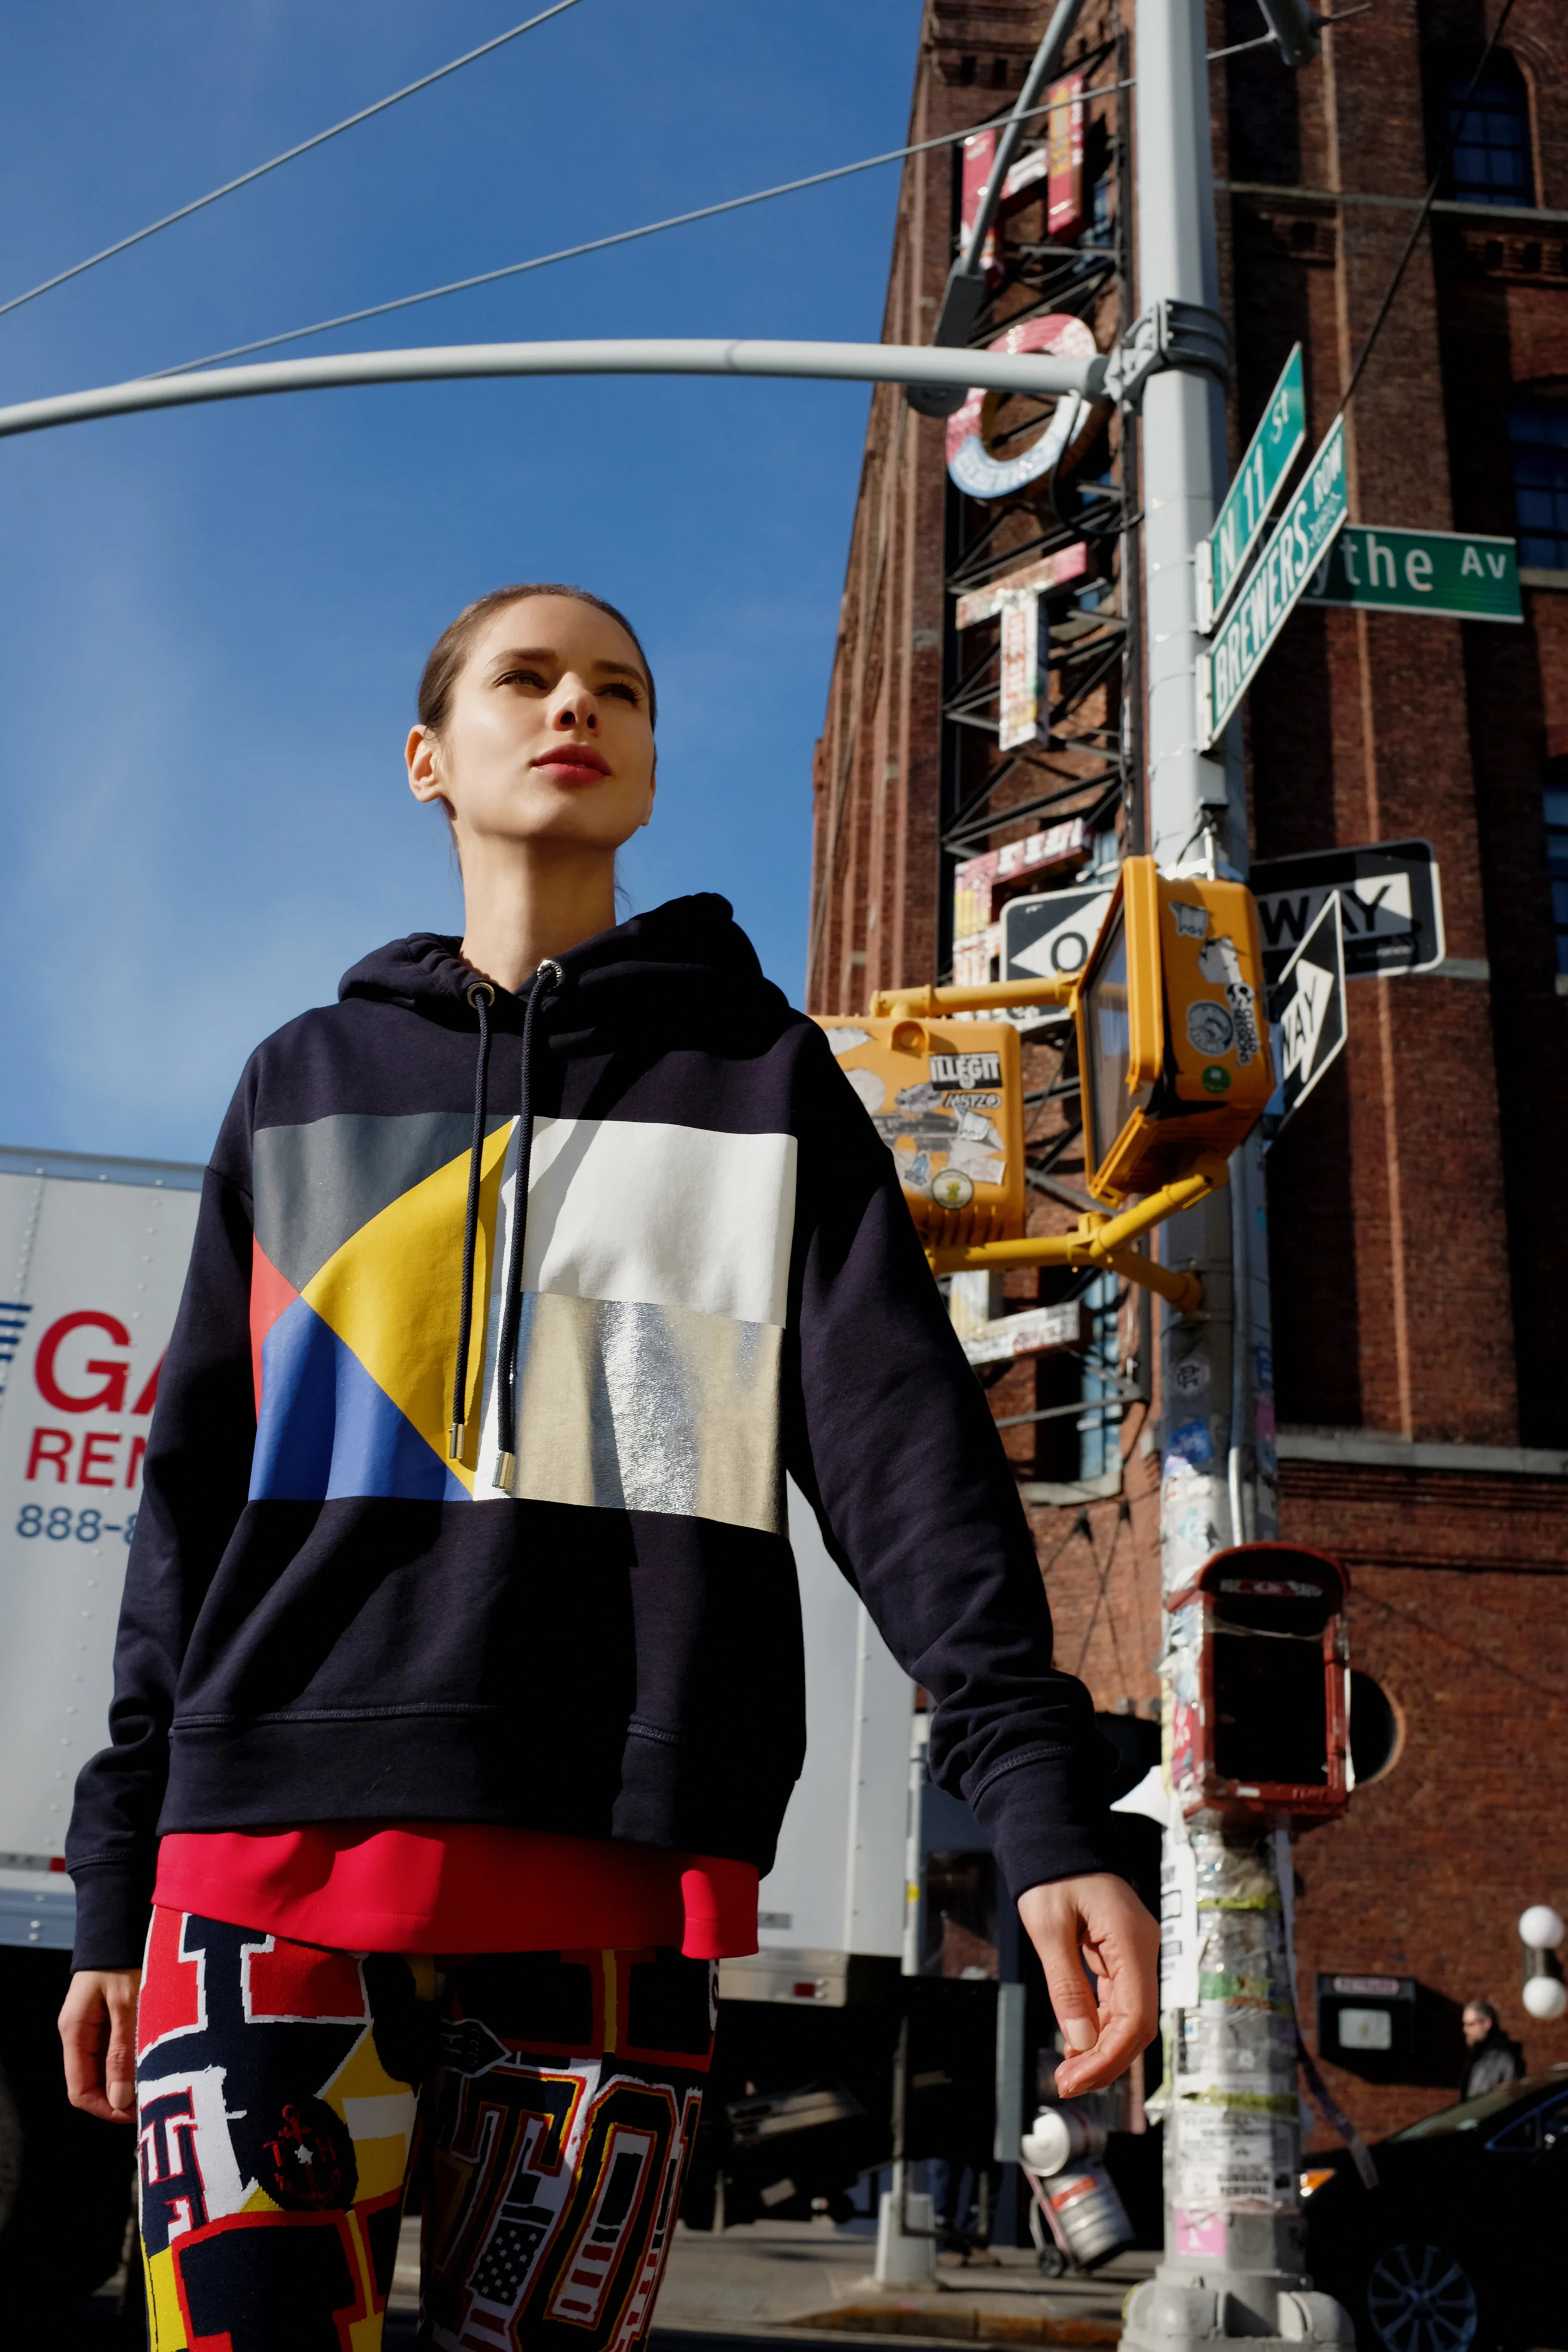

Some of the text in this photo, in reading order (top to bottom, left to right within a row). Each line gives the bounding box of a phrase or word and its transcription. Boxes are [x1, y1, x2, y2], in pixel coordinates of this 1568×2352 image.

[1219, 528, 1237, 592] N
[1243, 444, 1266, 533] 11
[1311, 532, 1506, 596] ythe Av
[1215, 499, 1310, 720] BREWERS
[1313, 433, 1343, 512] ROW
[930, 1052, 1001, 1083] ILLEGIT
